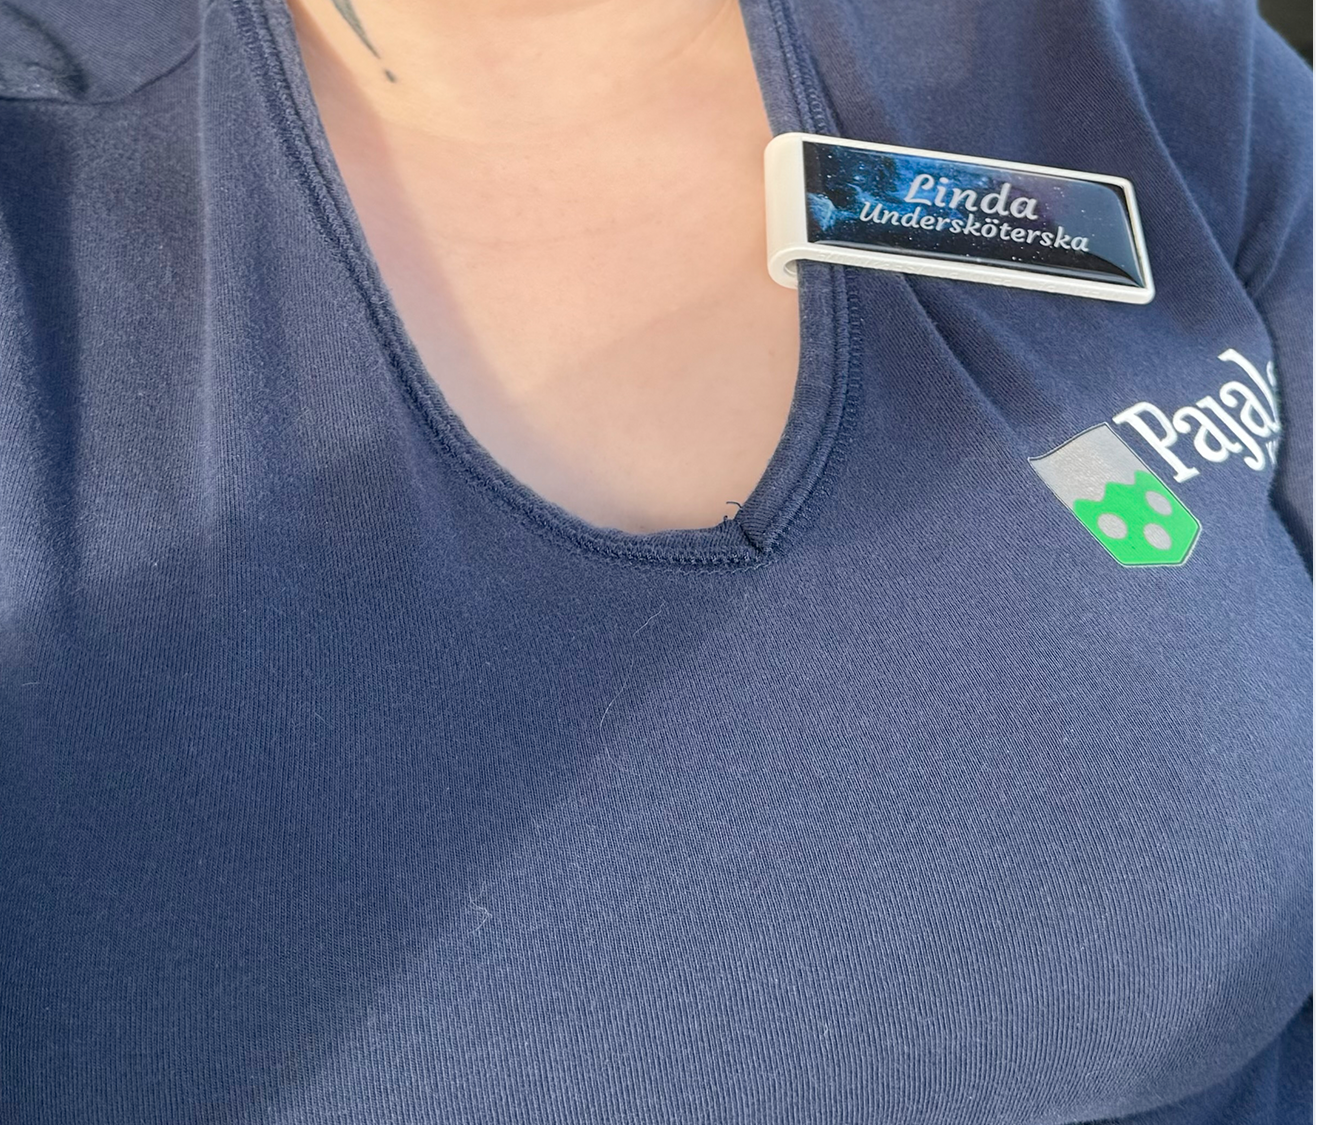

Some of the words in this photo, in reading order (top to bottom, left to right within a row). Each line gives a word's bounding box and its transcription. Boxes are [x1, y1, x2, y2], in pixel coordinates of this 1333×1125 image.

[903, 173, 1039, 222] Linda
[858, 201, 1091, 253] Undersköterska
[1112, 347, 1281, 483] Pajal
